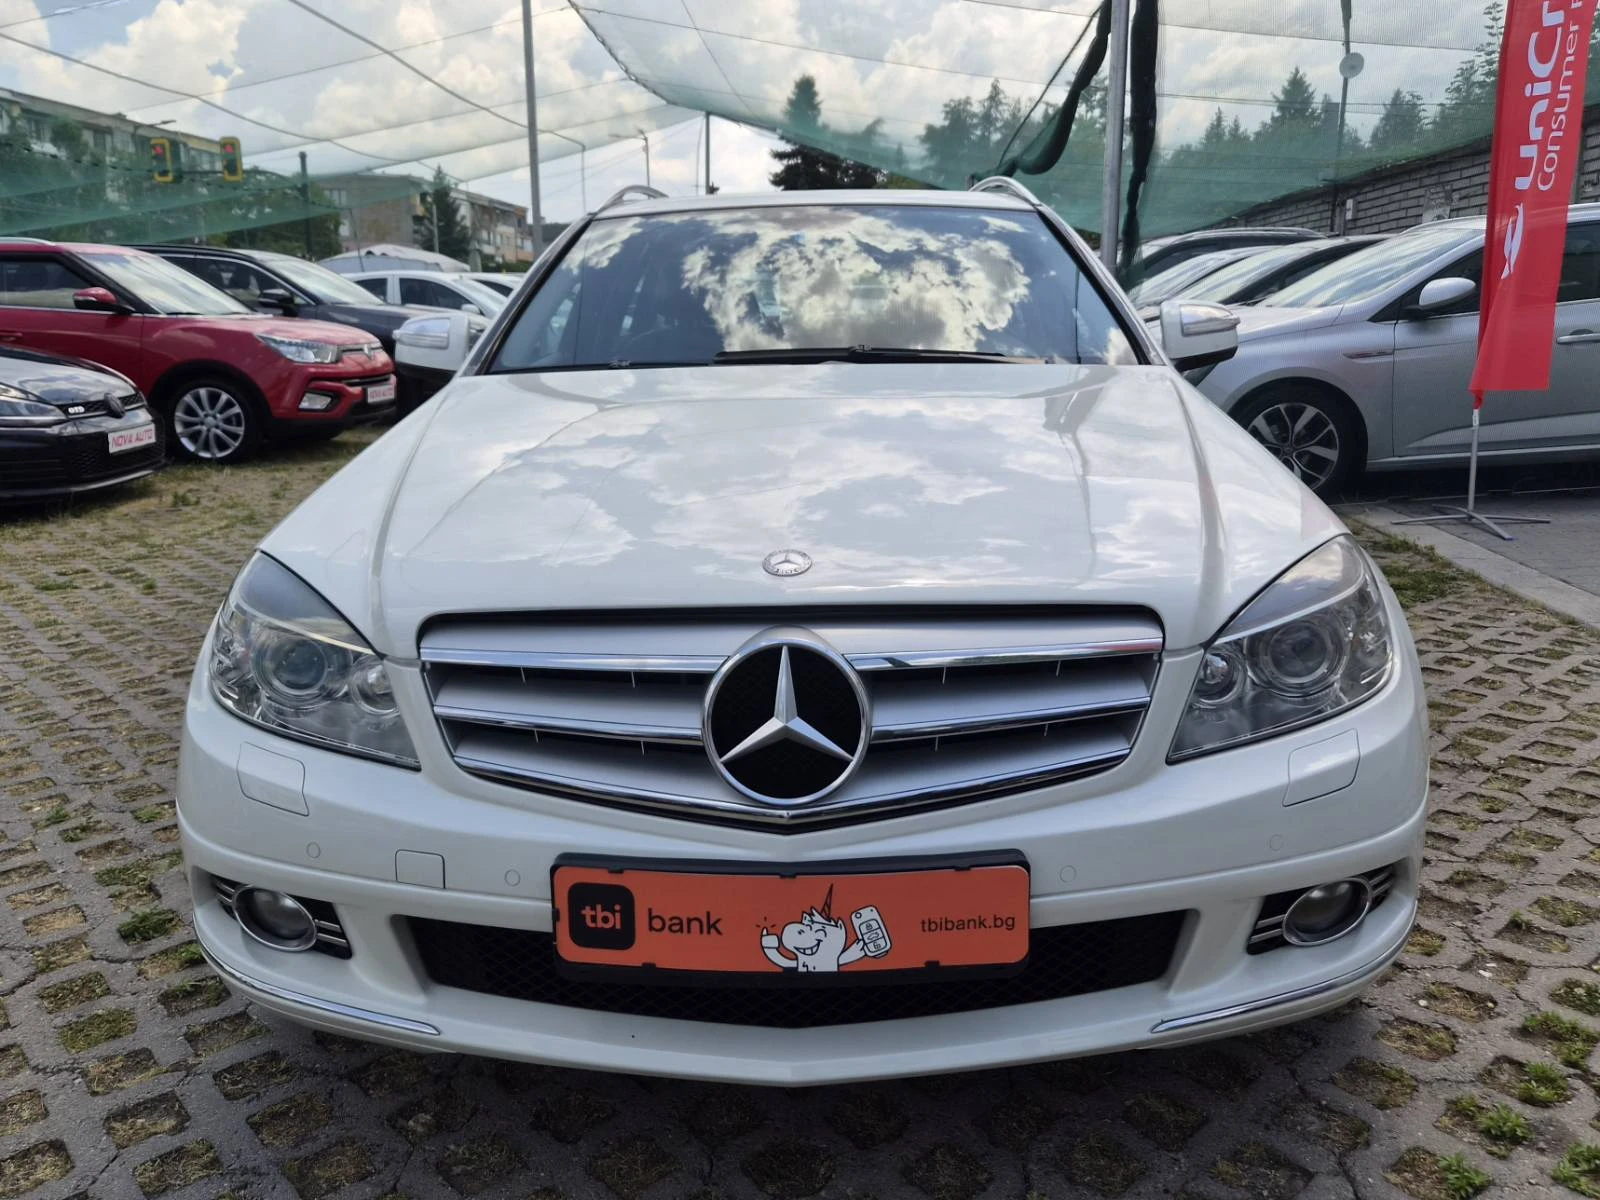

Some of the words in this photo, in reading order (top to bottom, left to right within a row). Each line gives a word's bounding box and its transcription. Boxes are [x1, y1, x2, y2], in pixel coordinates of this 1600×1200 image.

[1537, 20, 1580, 191] Consumer
[111, 433, 133, 449] NOVA
[135, 428, 153, 443] AUTO
[581, 904, 622, 930] tbi
[648, 908, 723, 936] bank
[920, 915, 1016, 933] tbibank.bg
